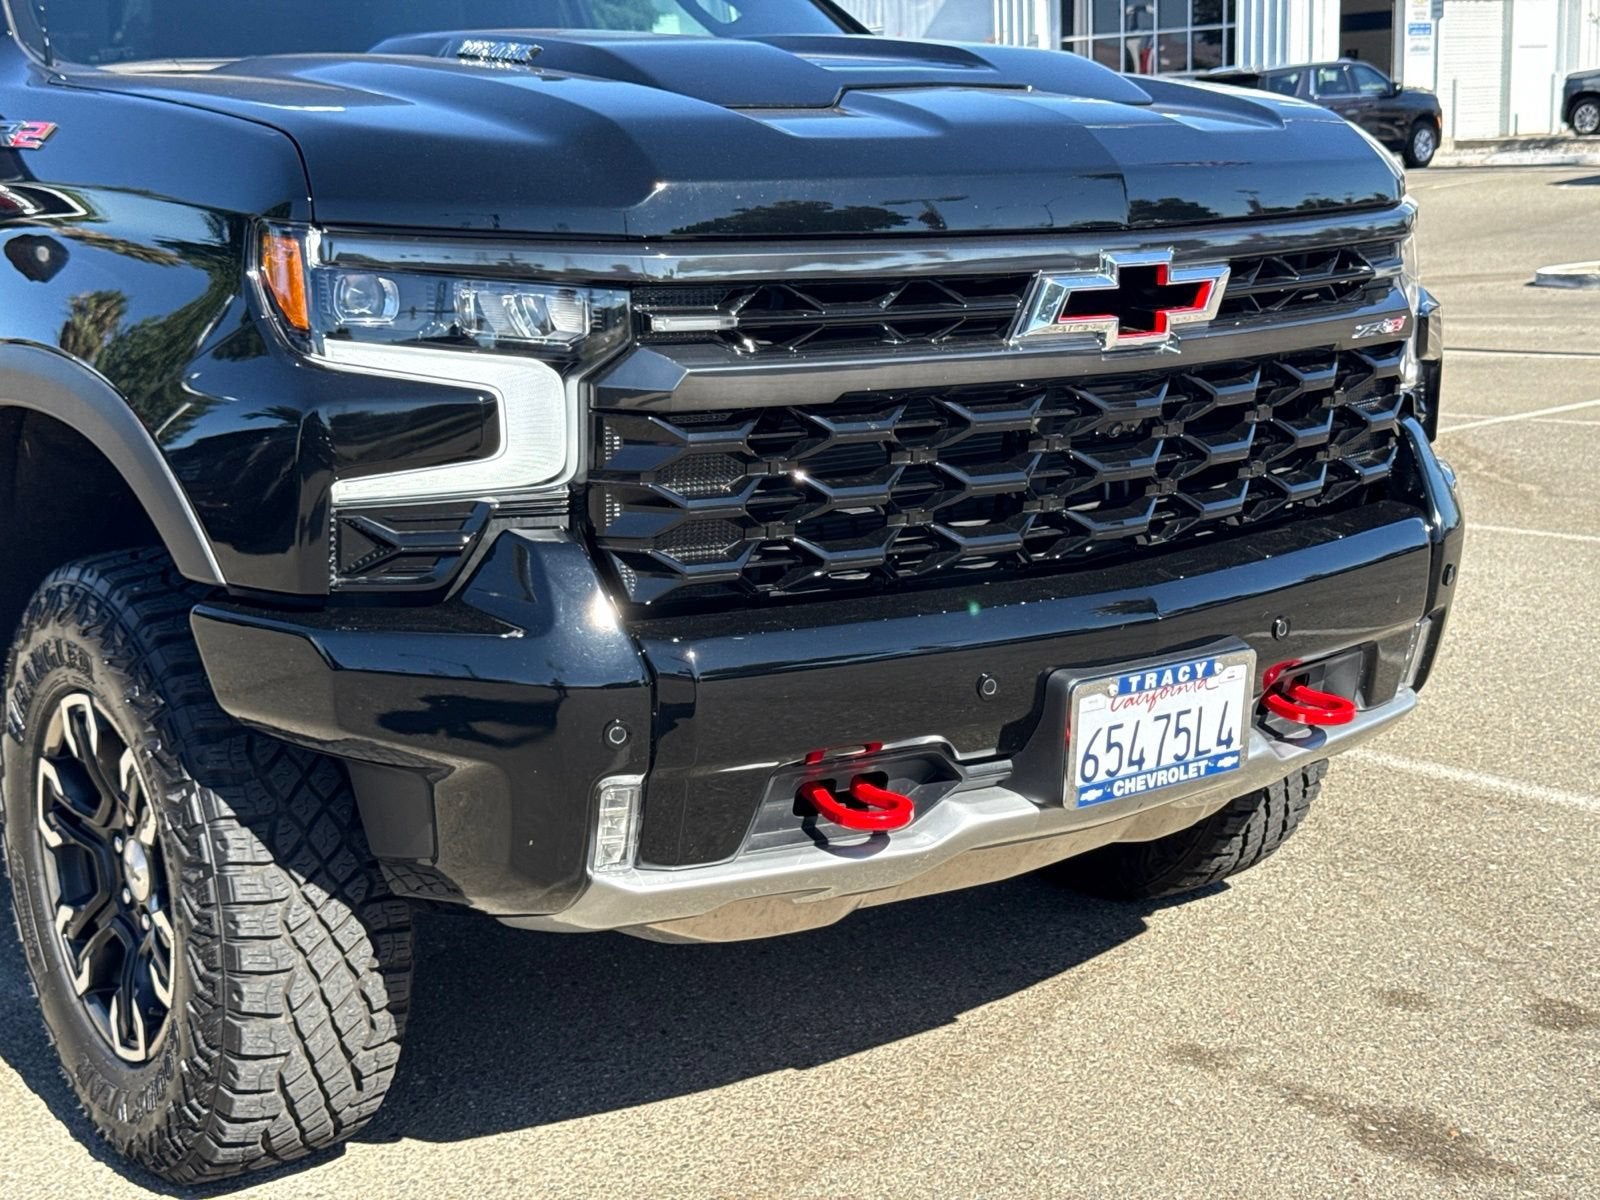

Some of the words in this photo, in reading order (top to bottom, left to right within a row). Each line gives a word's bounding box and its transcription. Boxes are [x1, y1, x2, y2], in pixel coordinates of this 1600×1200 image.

[8, 636, 97, 745] WRANGLER
[1110, 677, 1219, 713] California
[1129, 661, 1209, 692] TRACY
[1080, 700, 1234, 783] 65475L4
[1113, 759, 1208, 797] CHEVROLET
